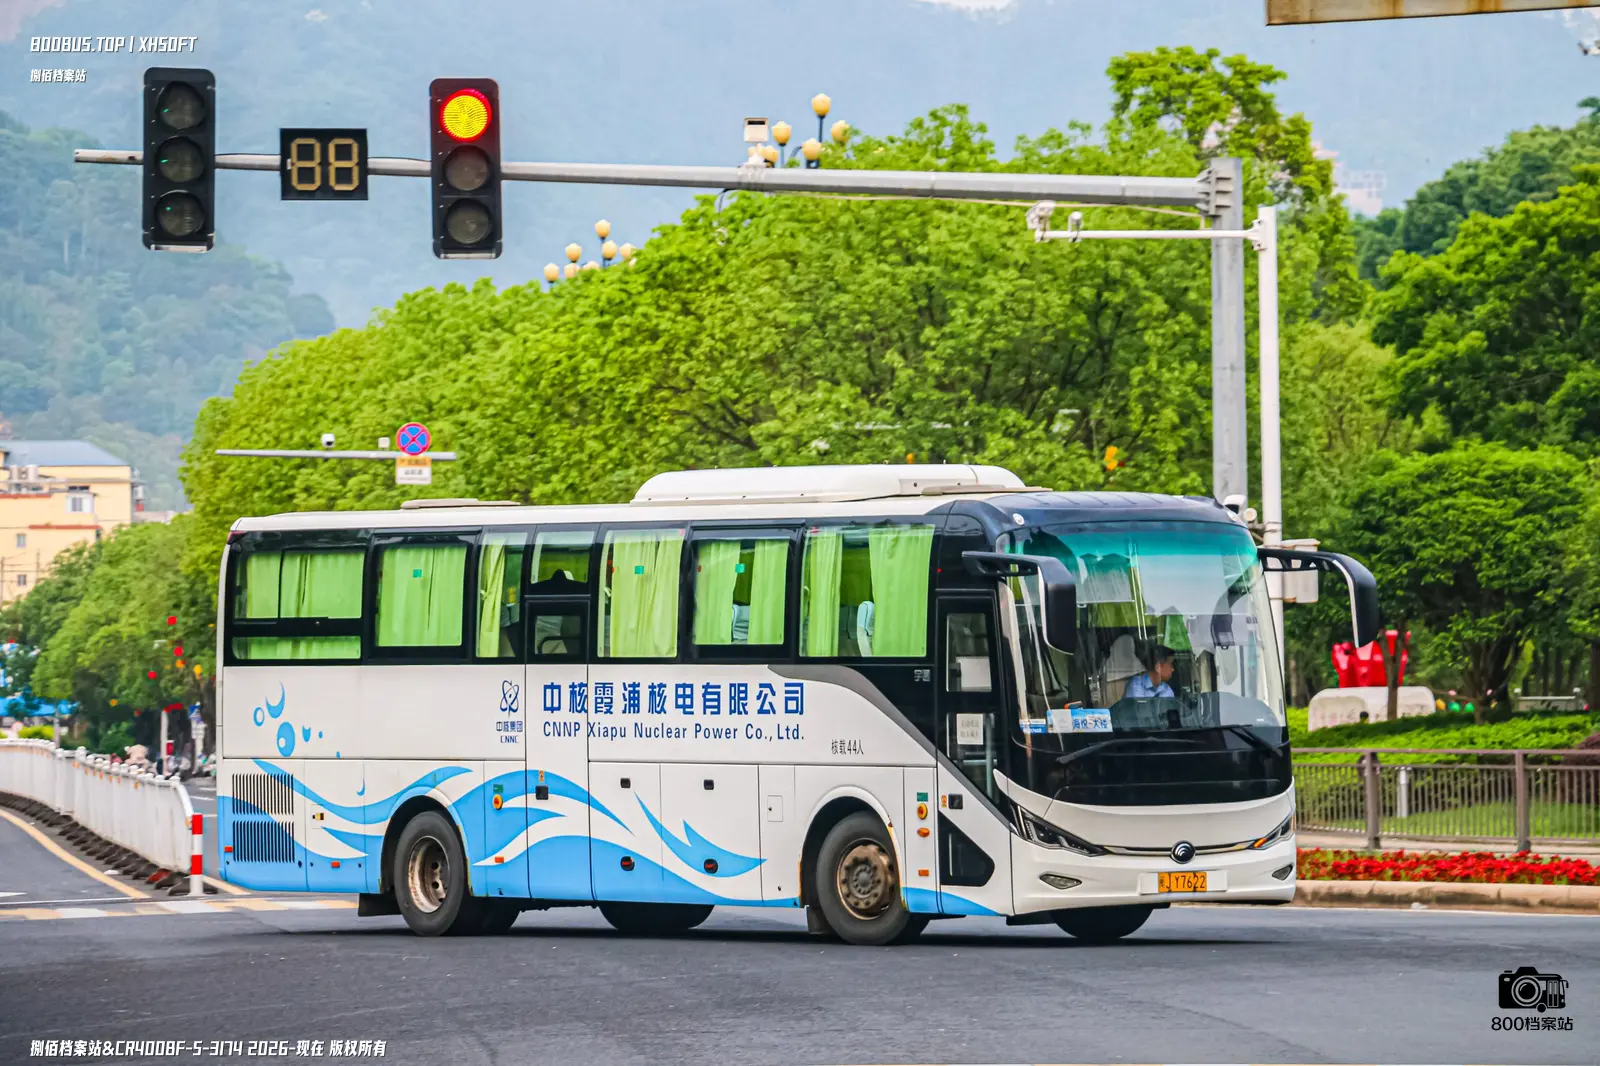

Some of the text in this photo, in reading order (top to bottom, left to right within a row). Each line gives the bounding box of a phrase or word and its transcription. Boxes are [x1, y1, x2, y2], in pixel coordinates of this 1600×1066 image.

[543, 682, 804, 715] 中核霞浦核电有限公司
[543, 721, 581, 737] CNNP
[587, 722, 627, 741] Xiapu
[634, 722, 688, 738] Nuclear
[694, 723, 738, 739] Power
[831, 739, 864, 755] 核载44人
